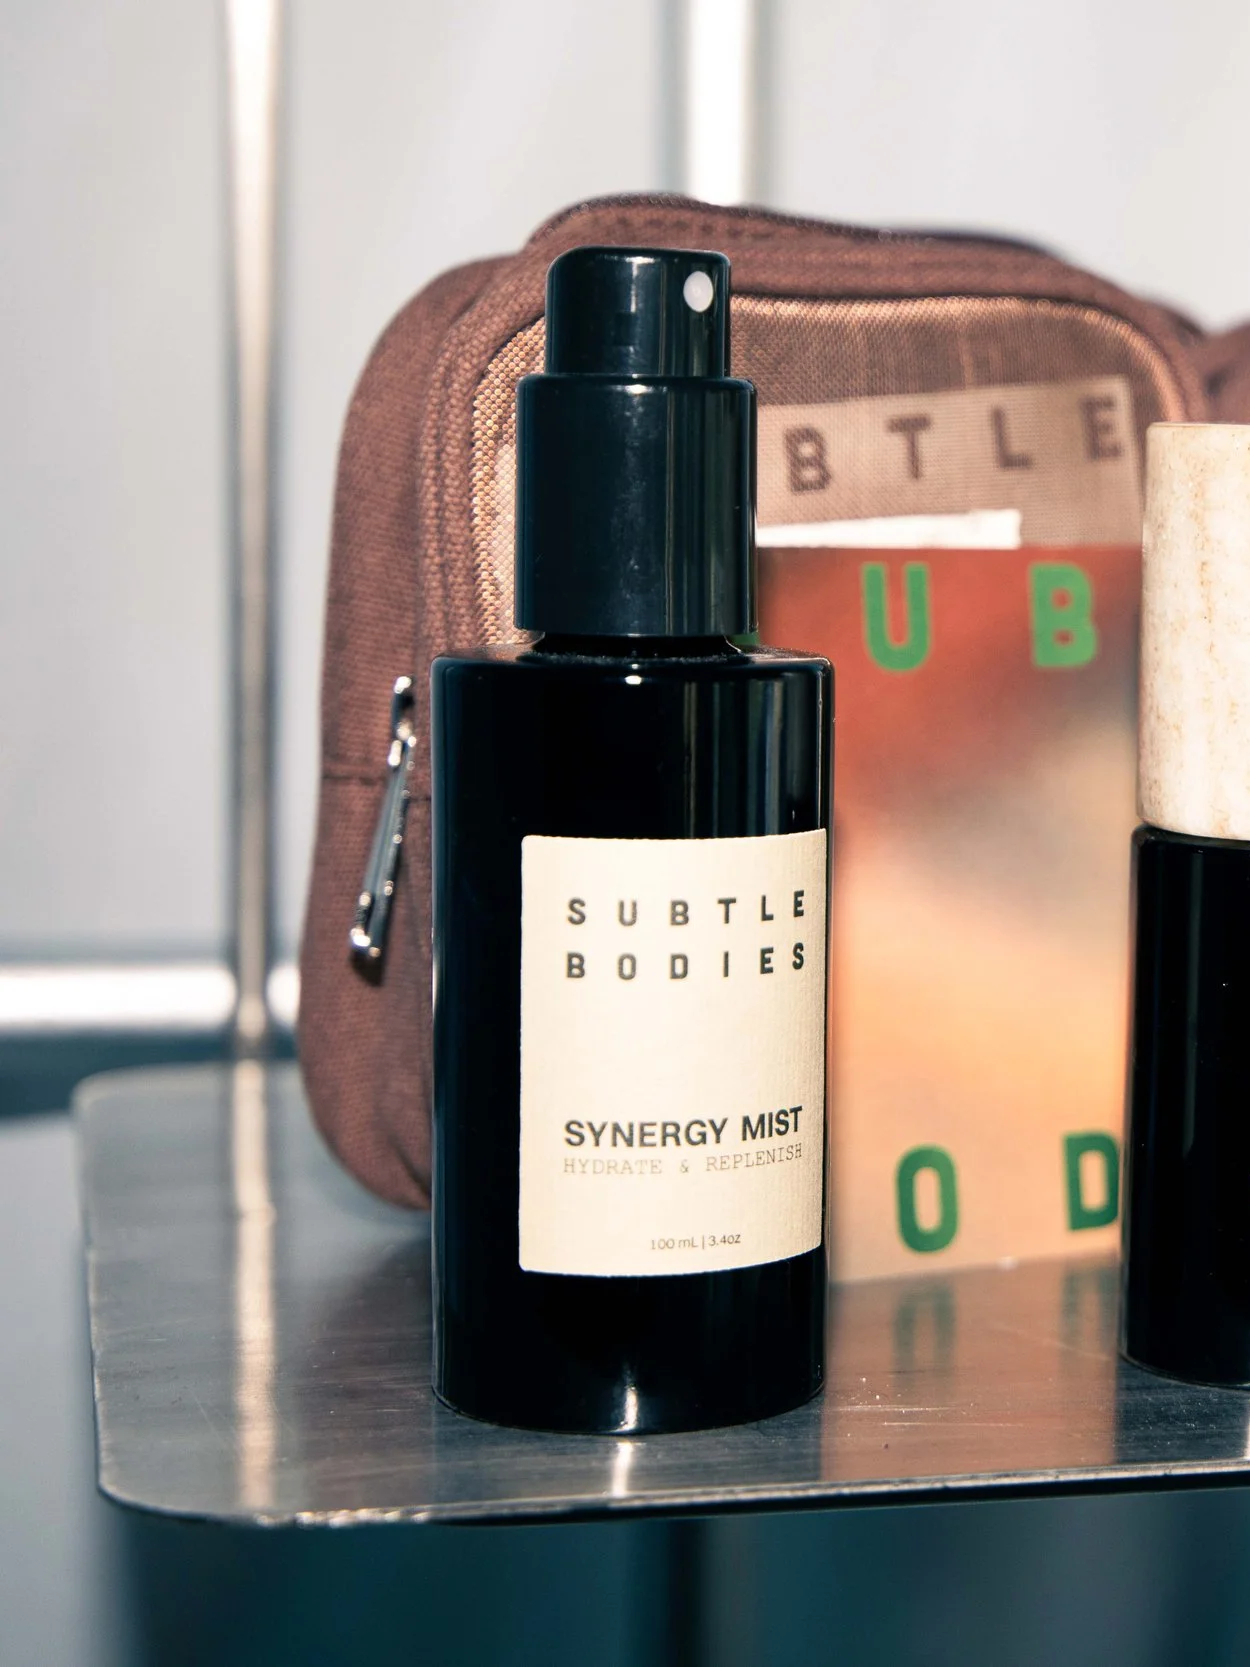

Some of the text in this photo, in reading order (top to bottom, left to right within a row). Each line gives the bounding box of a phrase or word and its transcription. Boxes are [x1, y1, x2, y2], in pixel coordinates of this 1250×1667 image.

[783, 397, 1124, 494] BTLE
[567, 890, 805, 926] SUBTLE
[566, 942, 805, 981] BODIES
[564, 1105, 803, 1148] SYNERGY MIST
[563, 1143, 802, 1175] HYDRATE & REPLENISH
[651, 1238, 675, 1250] 100
[678, 1236, 699, 1249] mL
[708, 1233, 741, 1247] 3.4oz
